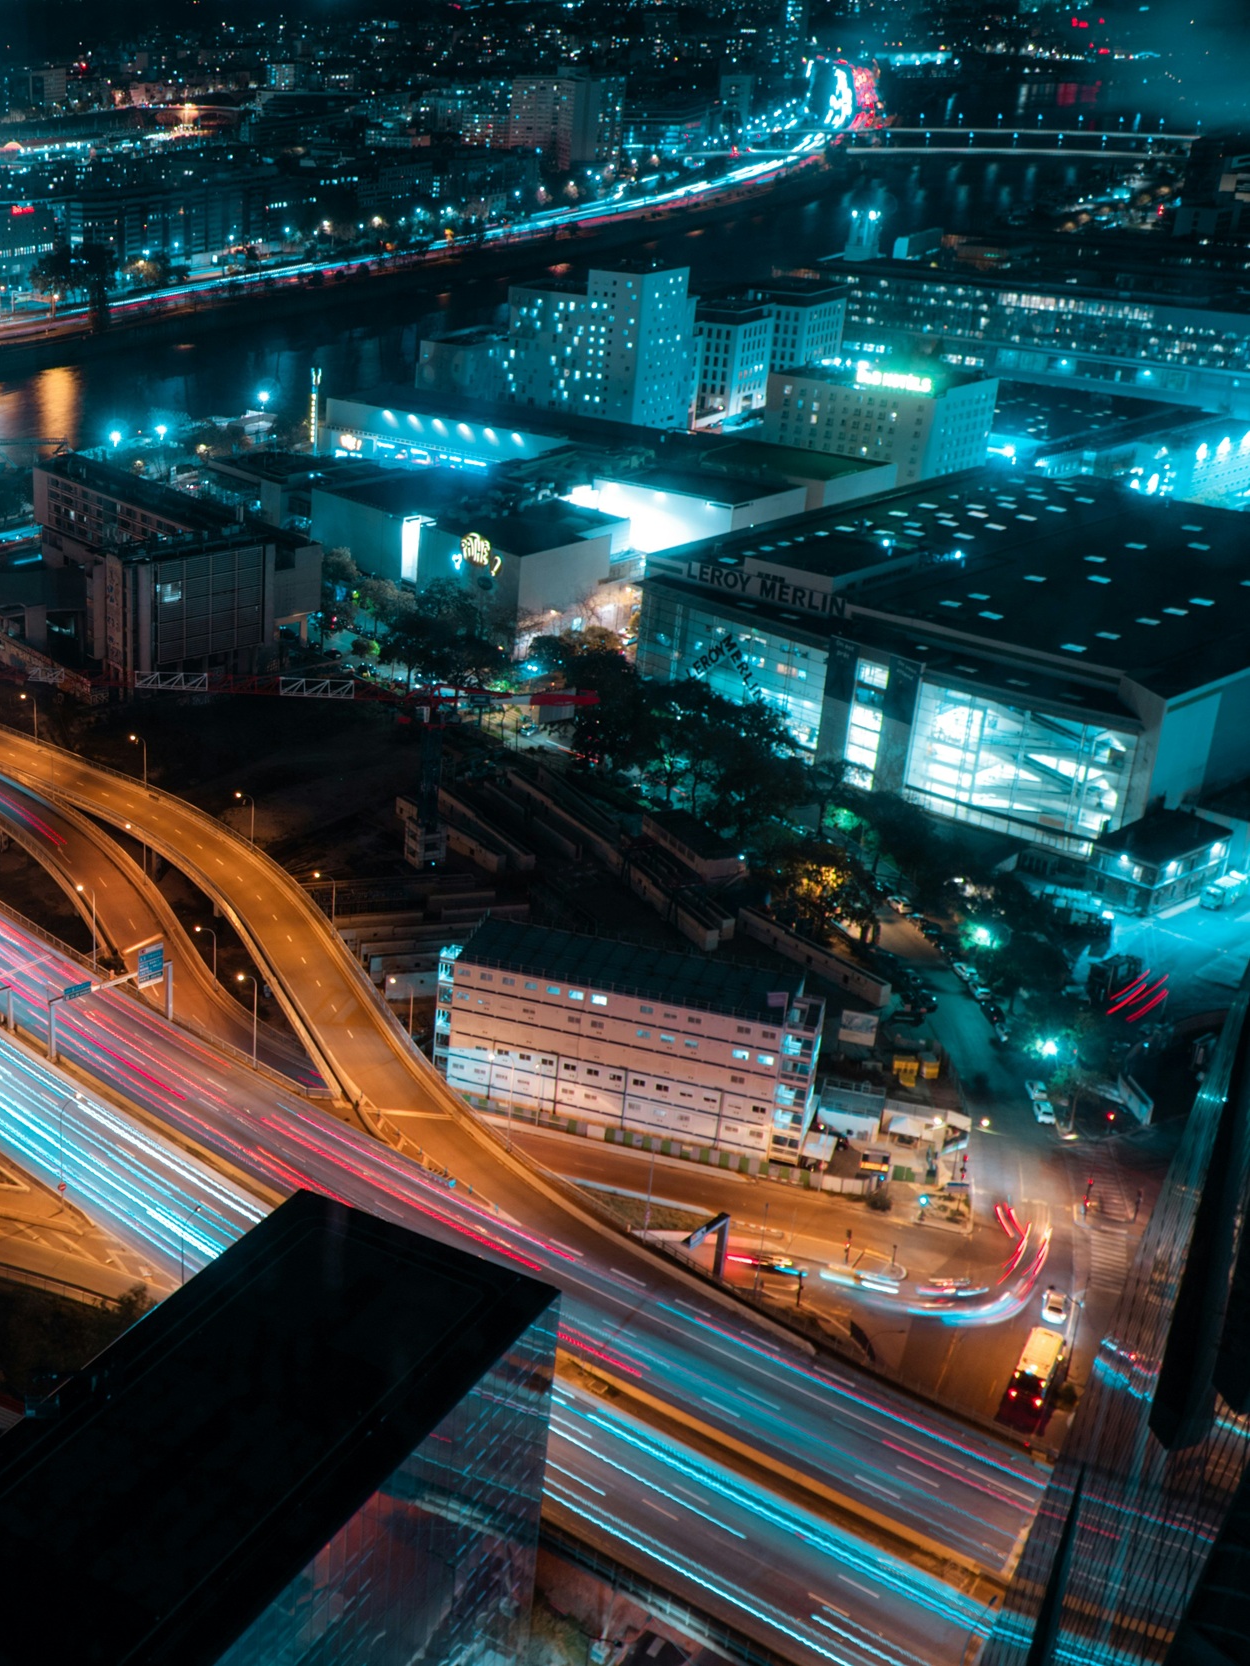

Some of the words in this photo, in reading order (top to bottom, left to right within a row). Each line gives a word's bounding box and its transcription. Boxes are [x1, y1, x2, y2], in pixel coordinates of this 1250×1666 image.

[687, 562, 751, 592] LEROY
[759, 579, 846, 618] MERLIN
[685, 640, 726, 680] LEROY
